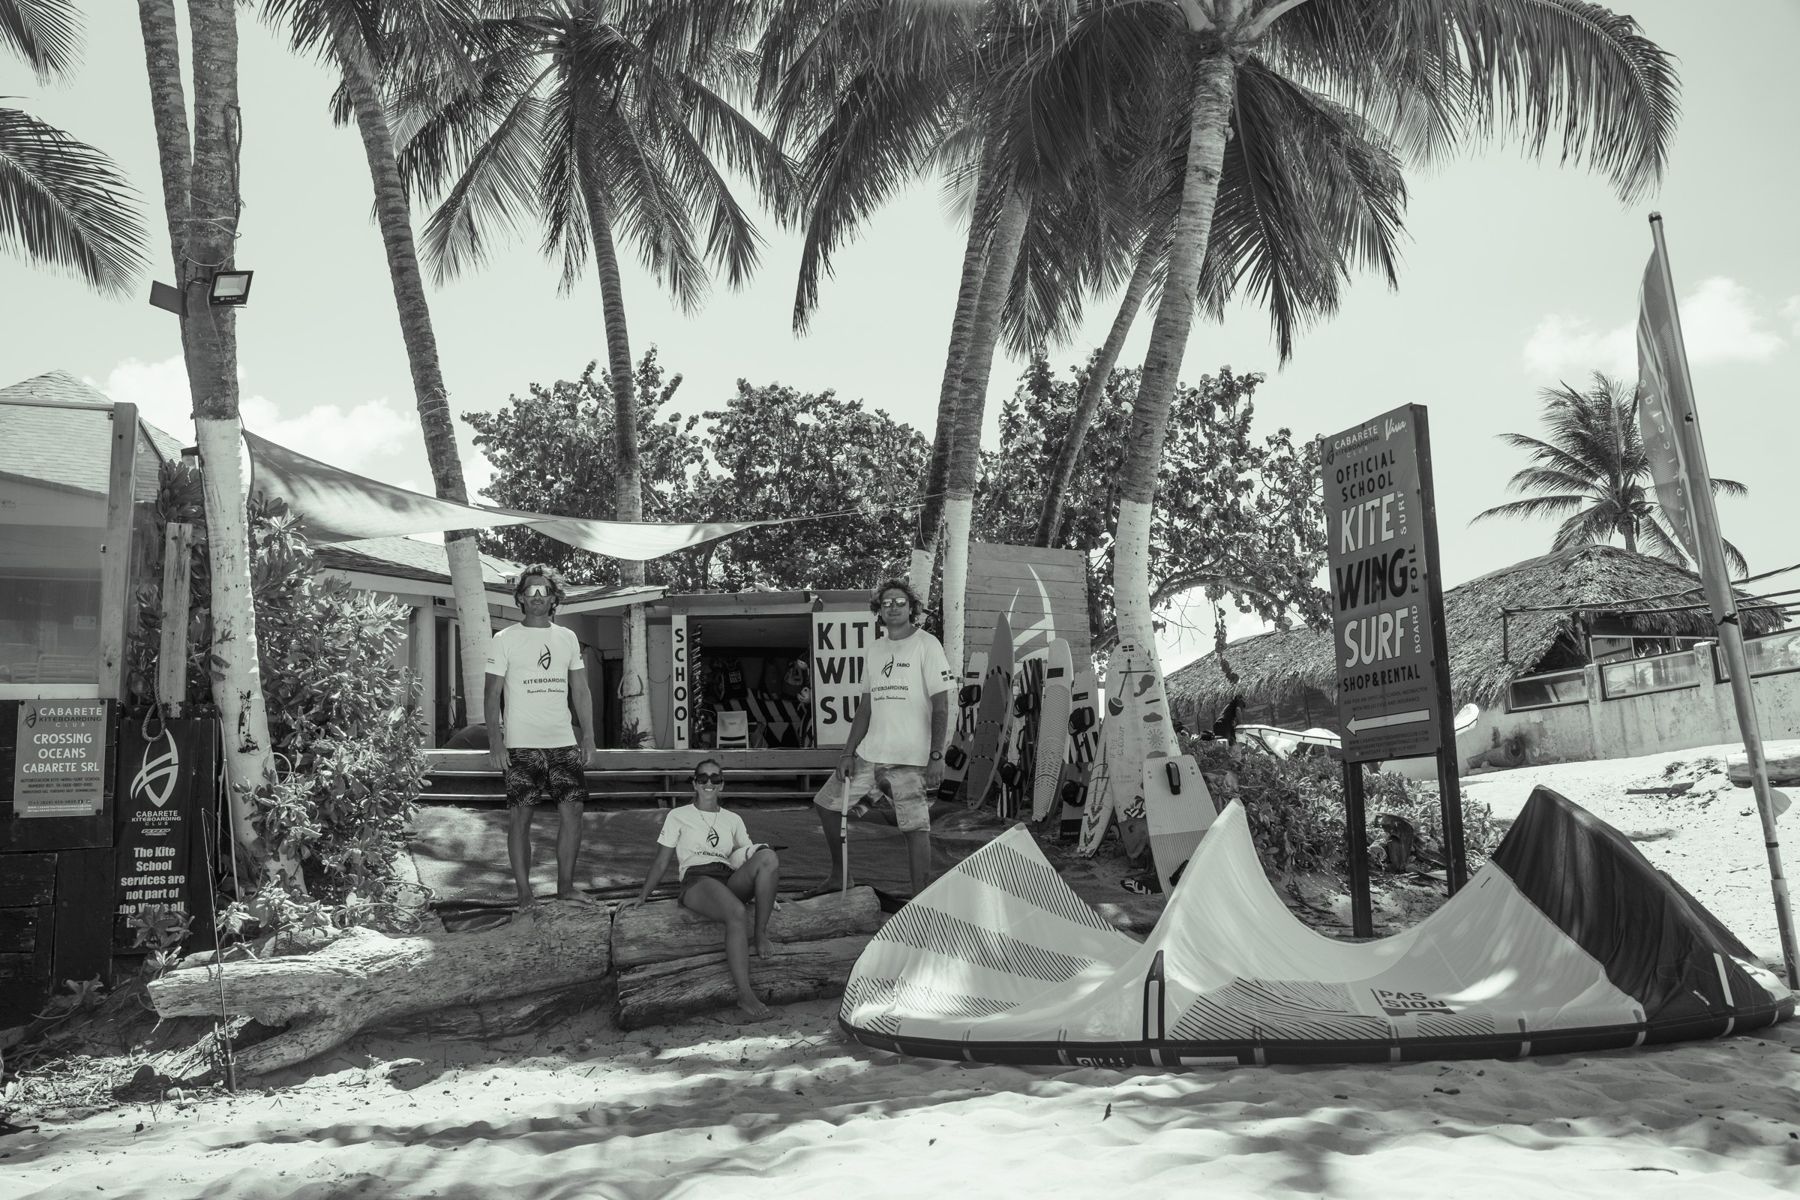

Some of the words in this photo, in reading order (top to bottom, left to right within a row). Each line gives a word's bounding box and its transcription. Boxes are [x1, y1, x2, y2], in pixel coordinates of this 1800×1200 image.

[1334, 425, 1378, 450] CABARETE
[1336, 449, 1395, 484] OFFICIAL
[1341, 470, 1394, 503] SCHOOL
[1341, 492, 1395, 554] KITE
[1409, 544, 1419, 593] FOIL
[1335, 548, 1408, 611] WING
[1411, 605, 1422, 653] BOARD
[1344, 607, 1409, 668] SURF
[674, 628, 688, 741] SCHOOL
[40, 707, 103, 716] CABARETE
[821, 695, 860, 725] SU
[33, 733, 92, 744] CROSSING
[38, 748, 86, 759] OCEANS
[22, 763, 77, 773] CABARETE
[81, 762, 99, 772] SRL
[135, 810, 178, 818] CABARETE
[134, 847, 153, 858] The
[155, 846, 176, 857] Kite
[136, 860, 172, 872] School
[120, 875, 166, 887] services
[167, 874, 185, 884] are
[126, 890, 143, 900] not
[144, 889, 167, 901] part
[168, 887, 180, 898] of
[170, 901, 184, 912] all
[1378, 990, 1427, 1000] PAS
[1384, 1000, 1447, 1008] SION
